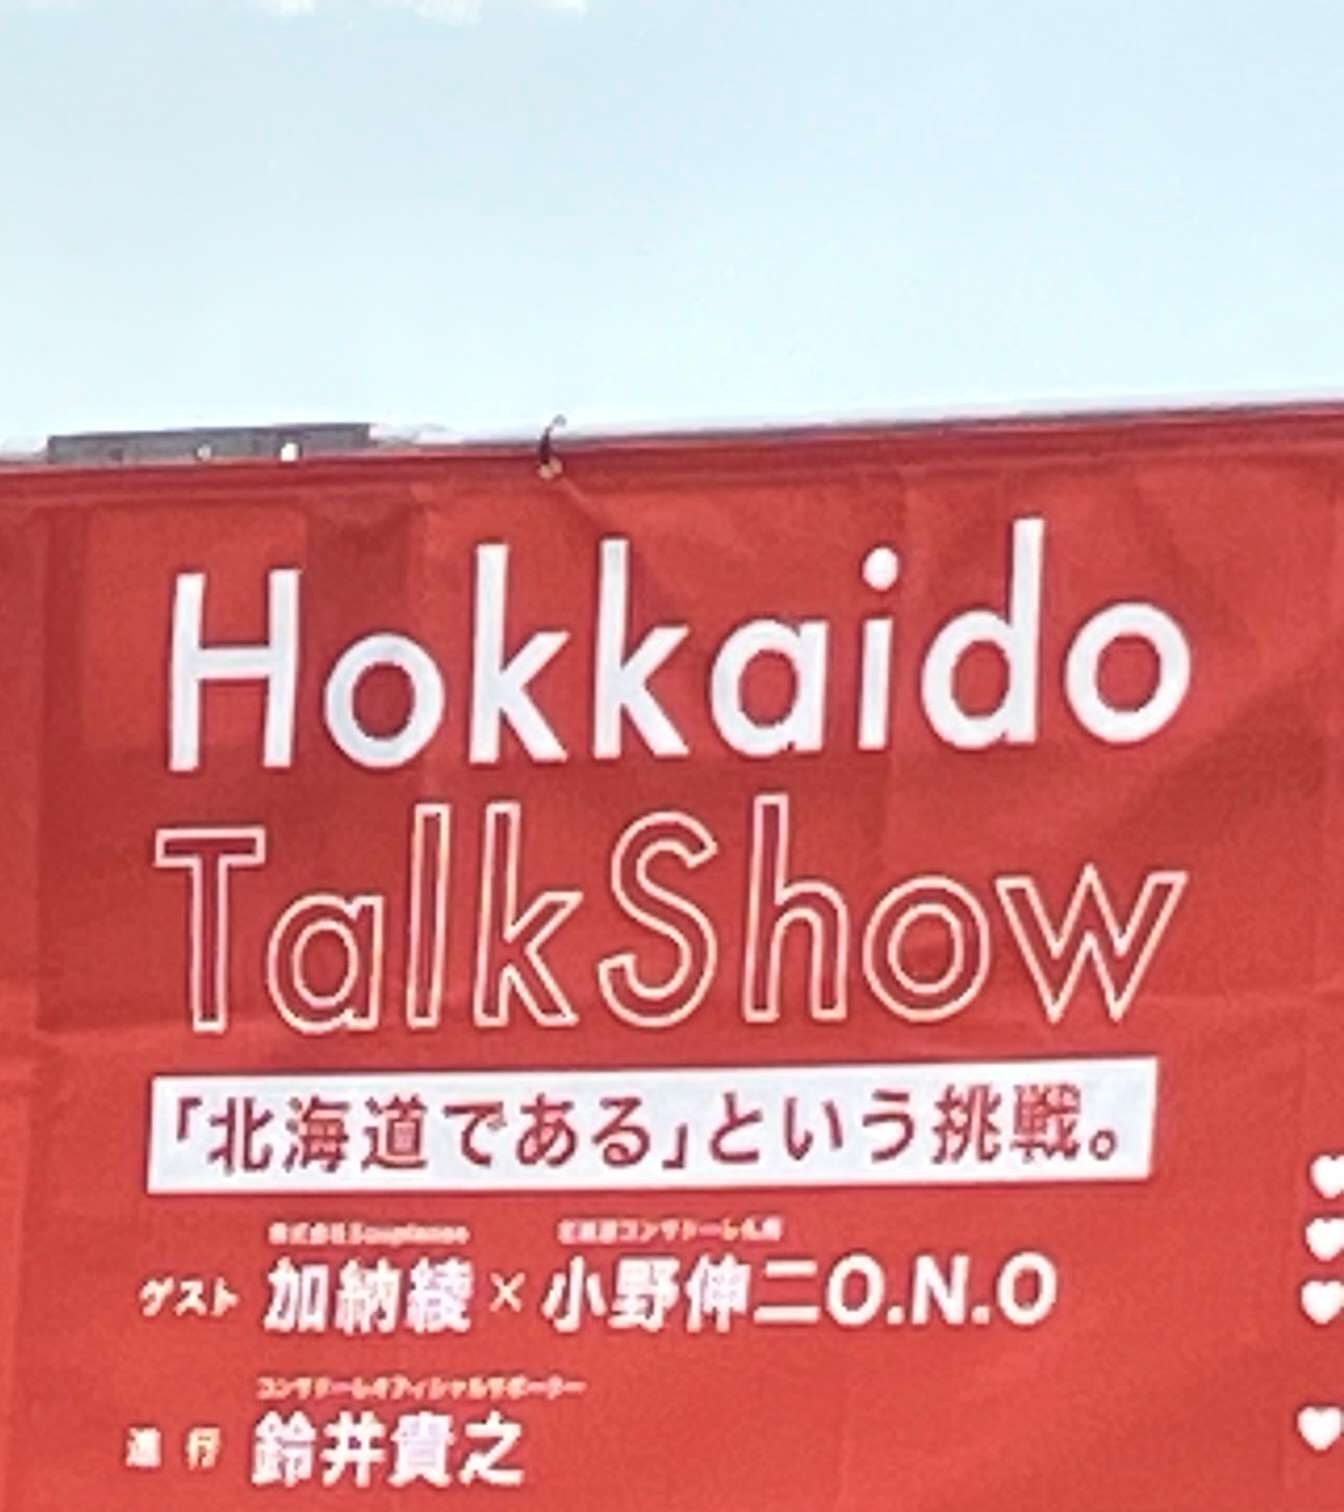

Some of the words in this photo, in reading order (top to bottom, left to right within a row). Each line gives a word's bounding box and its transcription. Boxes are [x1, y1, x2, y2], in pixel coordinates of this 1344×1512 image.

[169, 516, 1192, 772] Hokkaido
[174, 1083, 1119, 1176] 「北海道である」という挑戦。
[140, 1277, 239, 1317] ゲスト
[250, 1410, 524, 1487] 鈴井貴之
